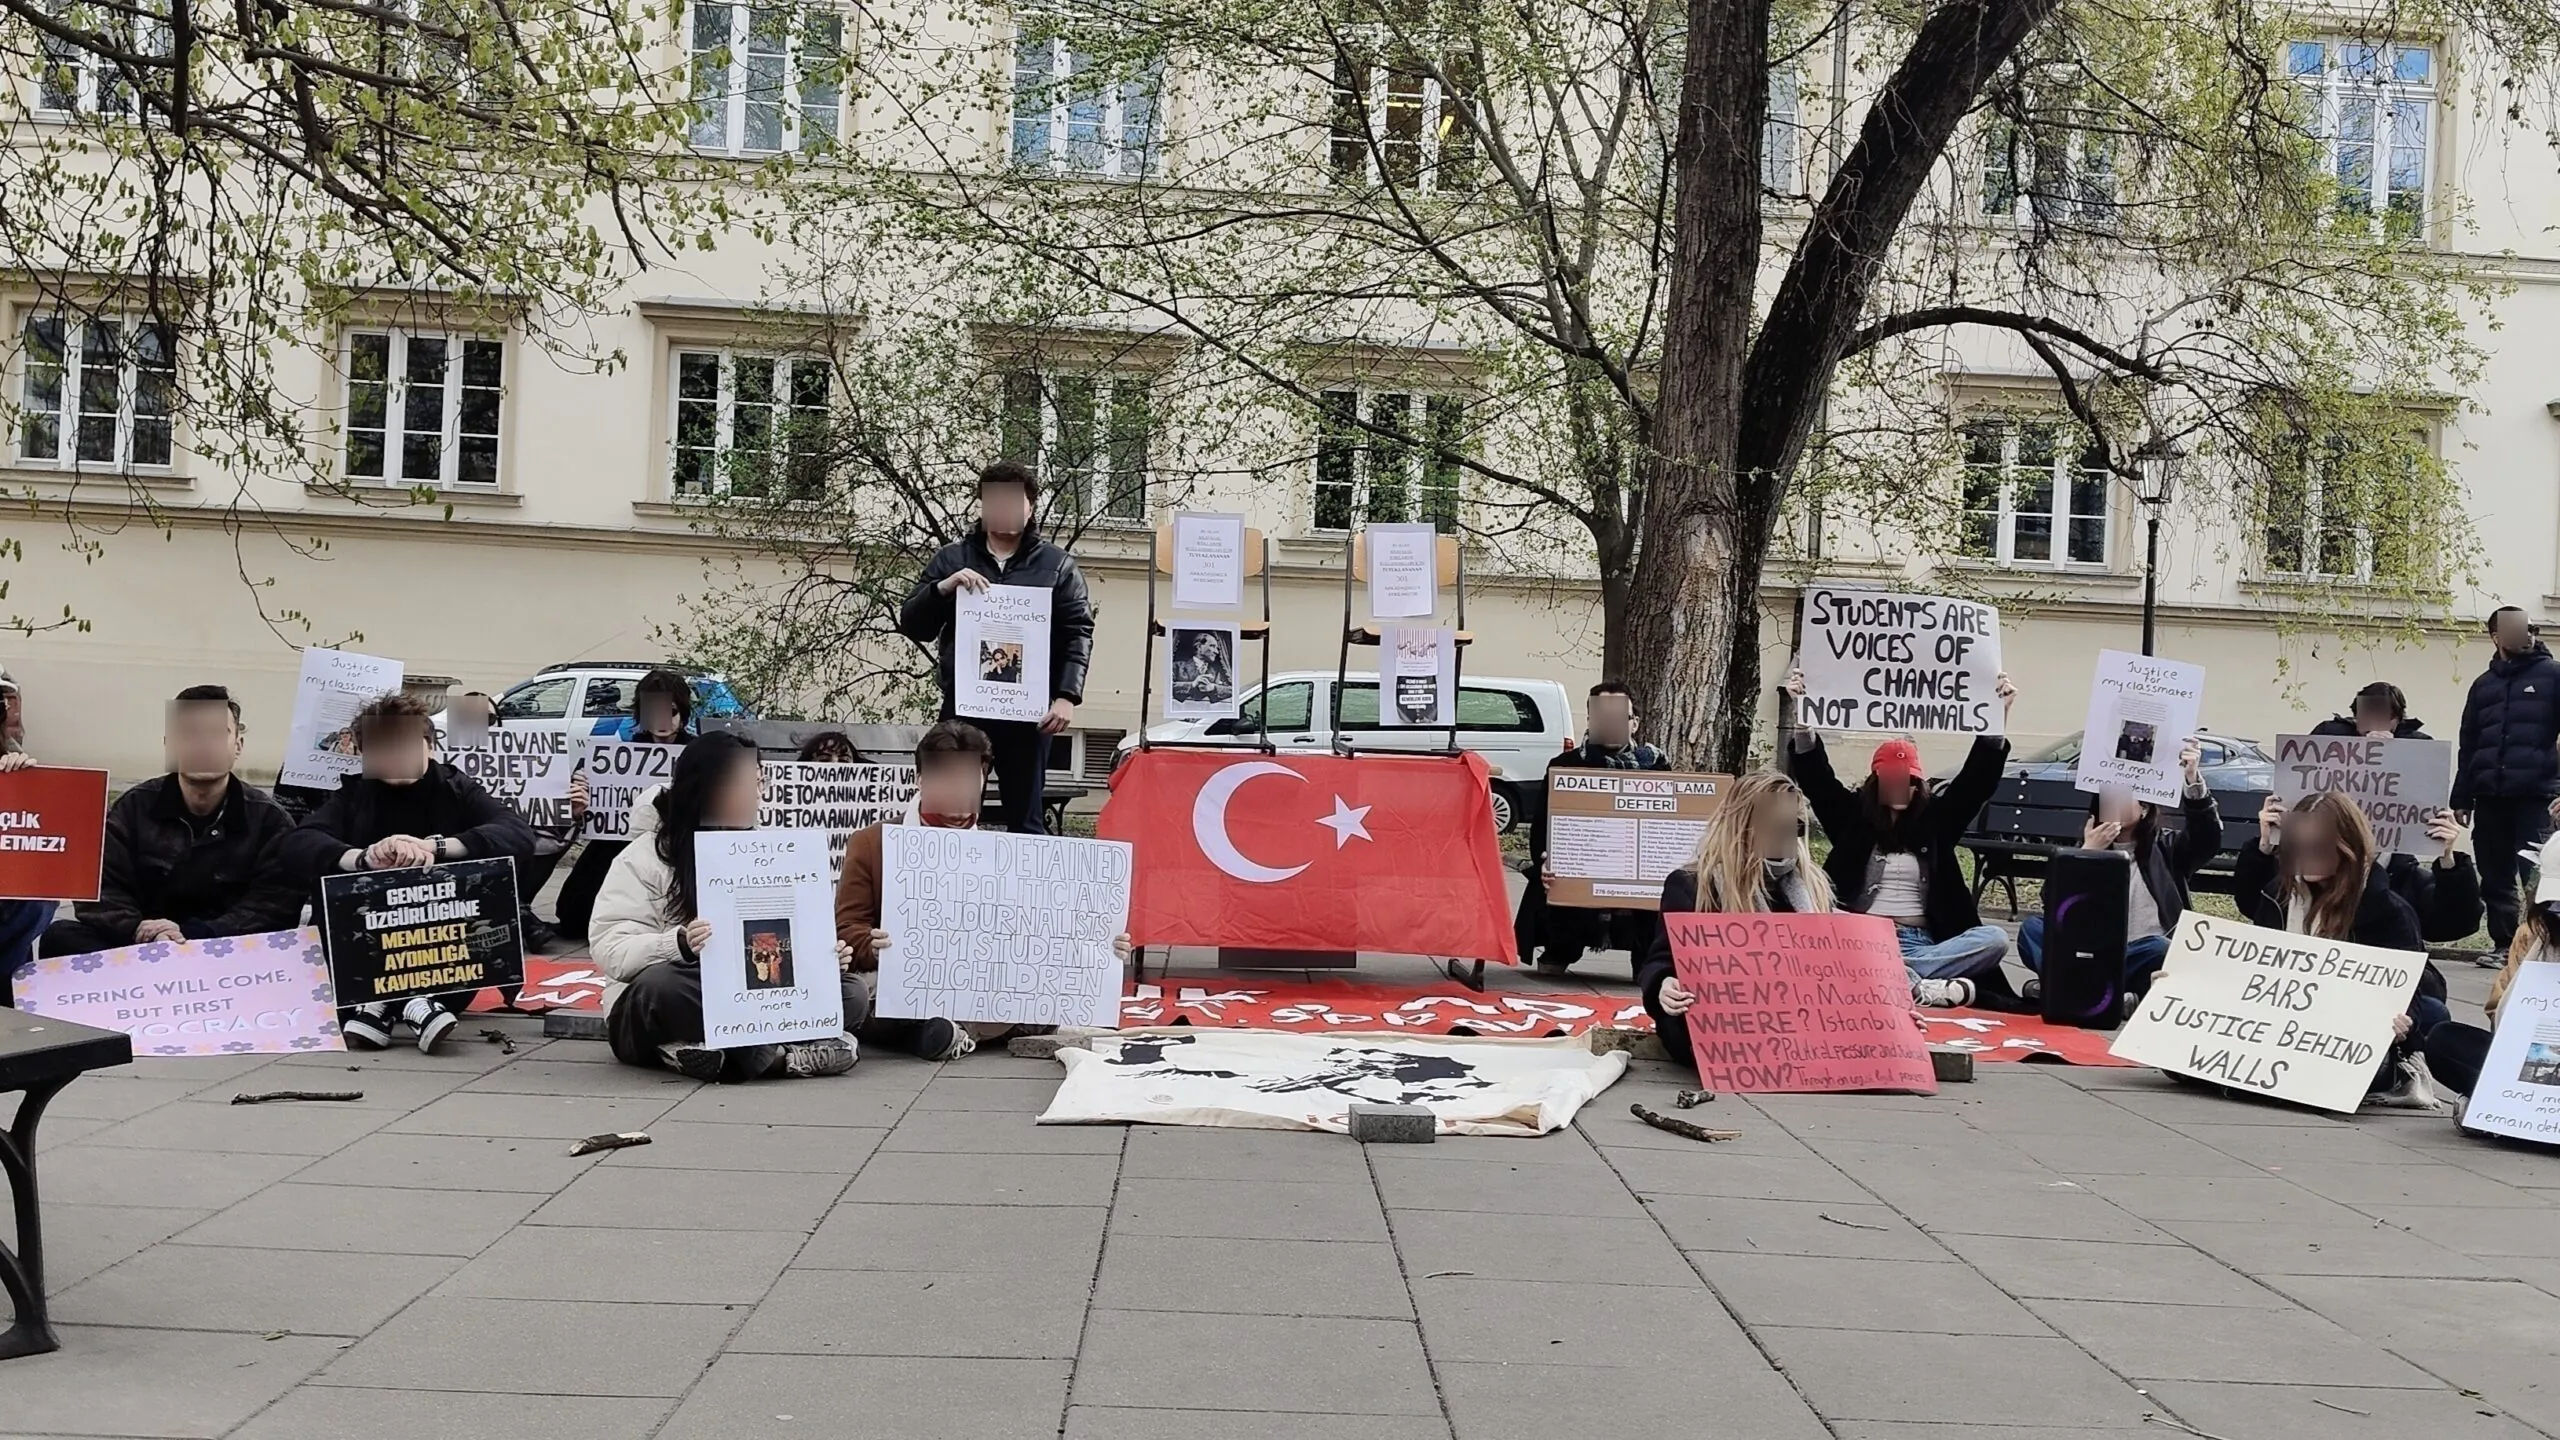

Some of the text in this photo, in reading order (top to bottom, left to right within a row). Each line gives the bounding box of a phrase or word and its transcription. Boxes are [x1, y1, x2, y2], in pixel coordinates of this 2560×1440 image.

[984, 592, 1031, 607] Justice
[963, 610, 1047, 622] my classmates
[1811, 591, 1990, 636] STUDENTS ARE
[1826, 629, 1974, 665] VOICES OF
[331, 657, 379, 674] Justice
[2128, 661, 2178, 680] Justice
[305, 675, 325, 691] my
[1863, 668, 1971, 701] CHANGE
[2102, 678, 2193, 699] my classmates
[2145, 674, 2162, 684] for
[976, 685, 1029, 700] and many
[958, 704, 1044, 717] remain detained
[1802, 697, 1989, 732] NOT CRIMINALS
[434, 729, 568, 754] RTOWANE
[2281, 739, 2384, 765] MAKE
[443, 753, 552, 778] KOBIETY
[591, 745, 669, 777] 5.072
[2100, 760, 2164, 780] and many
[283, 769, 326, 783] remain
[797, 765, 858, 782] TOMANIN
[859, 767, 879, 783] NE
[900, 767, 916, 785] VA
[1555, 777, 1618, 790] ADALET
[2115, 772, 2140, 780] more
[2291, 765, 2401, 796] TÜRKİYE
[795, 785, 856, 804] TOMANIN
[857, 786, 876, 803] NE
[1617, 798, 1675, 810] DEFTERİ
[0, 811, 41, 831] ÇLİK
[582, 810, 630, 835] POLİS
[792, 808, 857, 829] TOMANIN
[2357, 799, 2446, 824] MOCRACY
[0, 835, 66, 852] ETMEZ!
[728, 841, 796, 856] Justice
[994, 835, 1128, 885] DETAINED
[709, 877, 734, 893] my
[895, 869, 1125, 914] 101 POLITICIANS
[897, 898, 1113, 940] 13 JOURNALISTS
[381, 923, 468, 950] MEMLEKET
[1669, 919, 1769, 948] WHO?
[1775, 923, 1832, 950] Ekrem
[903, 928, 1111, 969] 301 STUDENTS
[2185, 920, 2409, 989] STUDENTS BEHIND
[1678, 951, 1782, 977] WHAT?
[56, 969, 292, 1006] SPRING WILL COME,
[903, 958, 1104, 997] 20 CHILDREN
[734, 987, 809, 1003] and many
[1681, 981, 1789, 1006] WHEN?
[1793, 984, 1813, 1004] In
[1817, 983, 1882, 1005] March
[2241, 974, 2318, 1011] BARS
[2521, 996, 2547, 1011] my
[117, 997, 234, 1021] BUT FIRST
[760, 1001, 793, 1012] more
[905, 988, 956, 1019] 11
[970, 991, 1096, 1026] ACTORS
[108, 1007, 304, 1037] MOCRACY
[714, 1012, 838, 1036] remain detained
[1691, 1008, 1904, 1035] WHERE? Istanbul
[2150, 996, 2373, 1065] JUSTICE BEHIND
[1702, 1037, 1780, 1065] WHY?
[1710, 1062, 1792, 1090] HOW?
[2189, 1044, 2289, 1089] WALLS
[2502, 1089, 2535, 1102] and
[2476, 1112, 2533, 1131] remain
